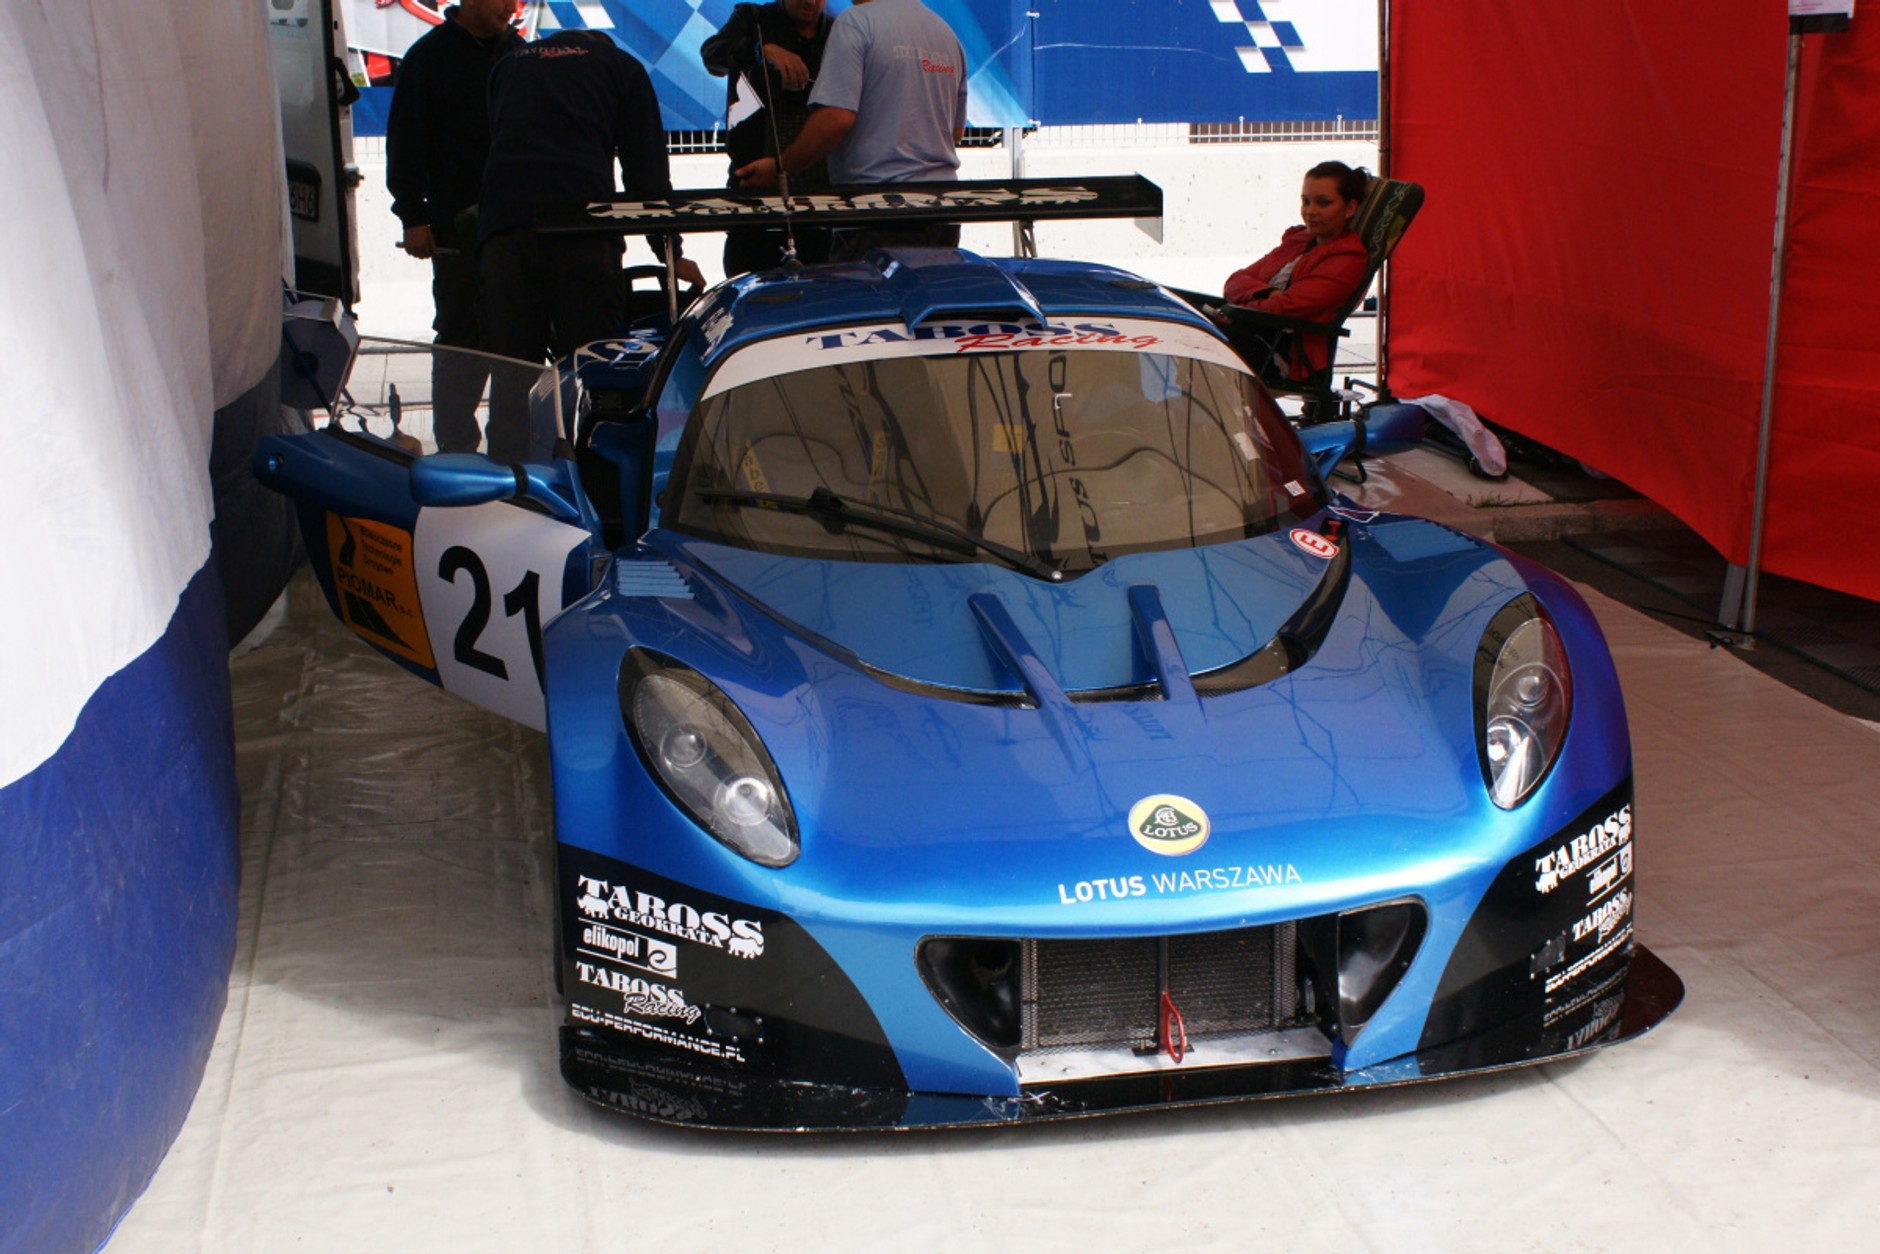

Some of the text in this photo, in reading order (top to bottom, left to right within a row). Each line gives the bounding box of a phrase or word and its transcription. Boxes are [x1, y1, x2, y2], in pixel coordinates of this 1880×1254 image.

[954, 331, 1164, 353] Racing
[336, 565, 398, 612] PIOMAR
[438, 545, 545, 697] 21
[1143, 821, 1199, 838] LOTUS
[1057, 863, 1303, 905] LOTUS WARSZAWA
[582, 923, 640, 960] elikopol
[613, 905, 724, 949] GEOKRATA
[623, 992, 702, 1026] Racing
